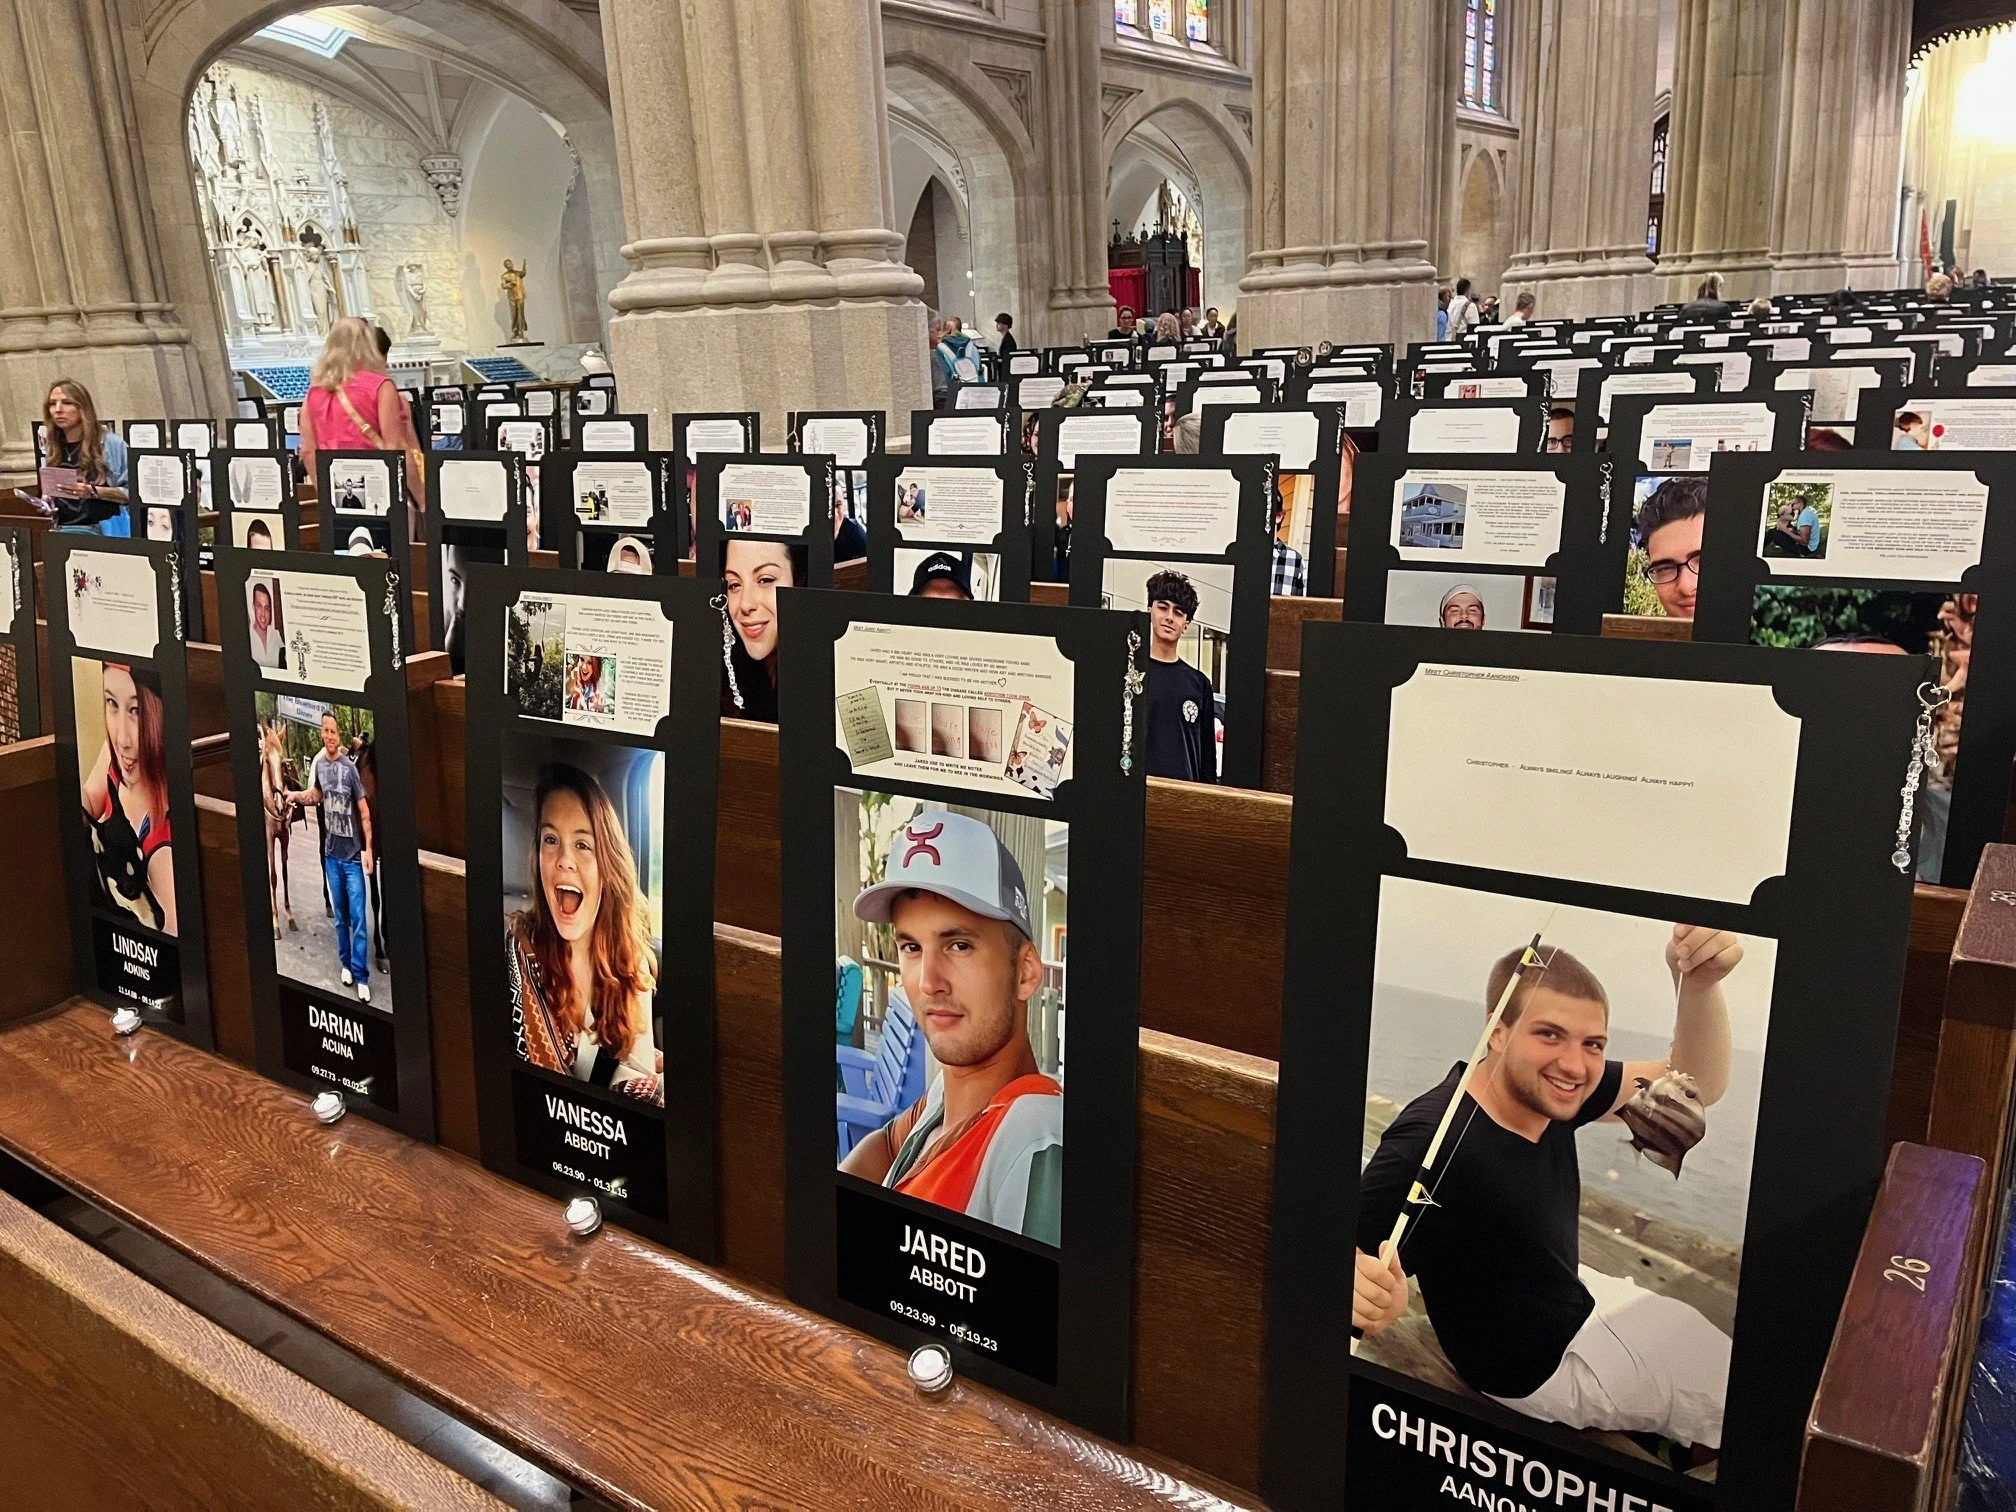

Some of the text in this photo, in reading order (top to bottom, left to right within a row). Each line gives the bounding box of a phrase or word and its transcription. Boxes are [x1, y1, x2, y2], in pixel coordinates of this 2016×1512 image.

[928, 564, 952, 572] adidas
[112, 932, 159, 967] LINDSAY
[123, 960, 151, 981] ADKINS
[308, 1005, 364, 1046] DARIAN
[322, 1037, 354, 1060] ACUNA
[545, 1094, 628, 1146] VANESSA
[564, 1131, 611, 1160] ABBOTT
[552, 1161, 585, 1182] 06.23.90
[899, 1224, 987, 1279] JARED
[909, 1264, 978, 1304] ABBOTT
[1883, 1255, 1931, 1292] 26
[889, 1300, 937, 1327] 09.23.99
[949, 1323, 998, 1351] 05.19.23
[1371, 1403, 1674, 1512] CHRISTOPHE
[1439, 1475, 1538, 1512] AANO
